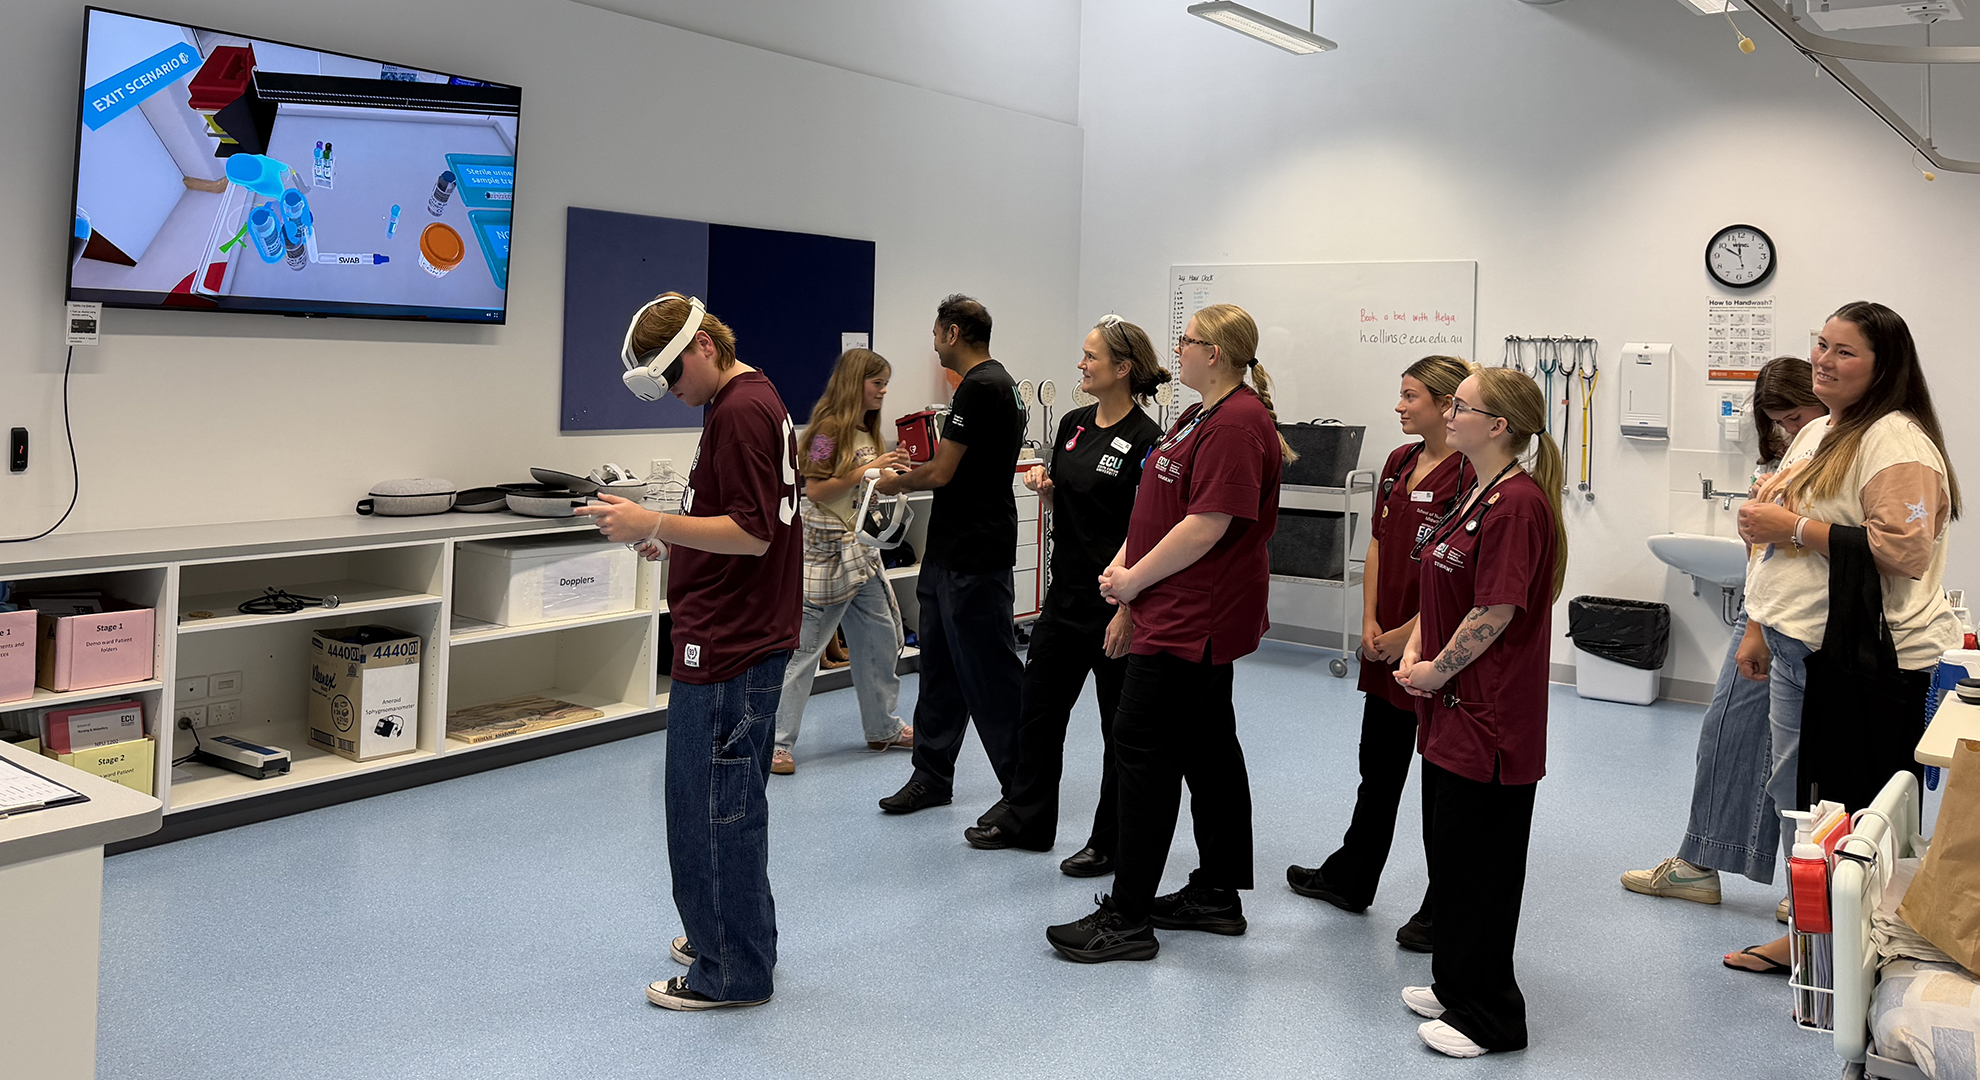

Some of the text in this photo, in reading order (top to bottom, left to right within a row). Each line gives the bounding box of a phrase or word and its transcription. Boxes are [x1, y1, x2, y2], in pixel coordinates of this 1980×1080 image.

[92, 58, 180, 113] EXIT SCENARIO
[466, 168, 492, 176] Sterile
[471, 177, 500, 185] sample
[338, 256, 360, 264] SWAB
[1360, 308, 1378, 322] Book
[1412, 312, 1428, 322] with
[1434, 310, 1456, 326] Helga
[1100, 454, 1123, 470] ECU
[1157, 456, 1170, 467] ECU
[559, 576, 595, 587] Dopplers
[382, 697, 402, 705] Aneroid
[365, 703, 416, 715] Sphygmomanometer
[121, 715, 135, 723] ECU
[98, 757, 119, 766] Stage
[116, 768, 134, 776] Patient
